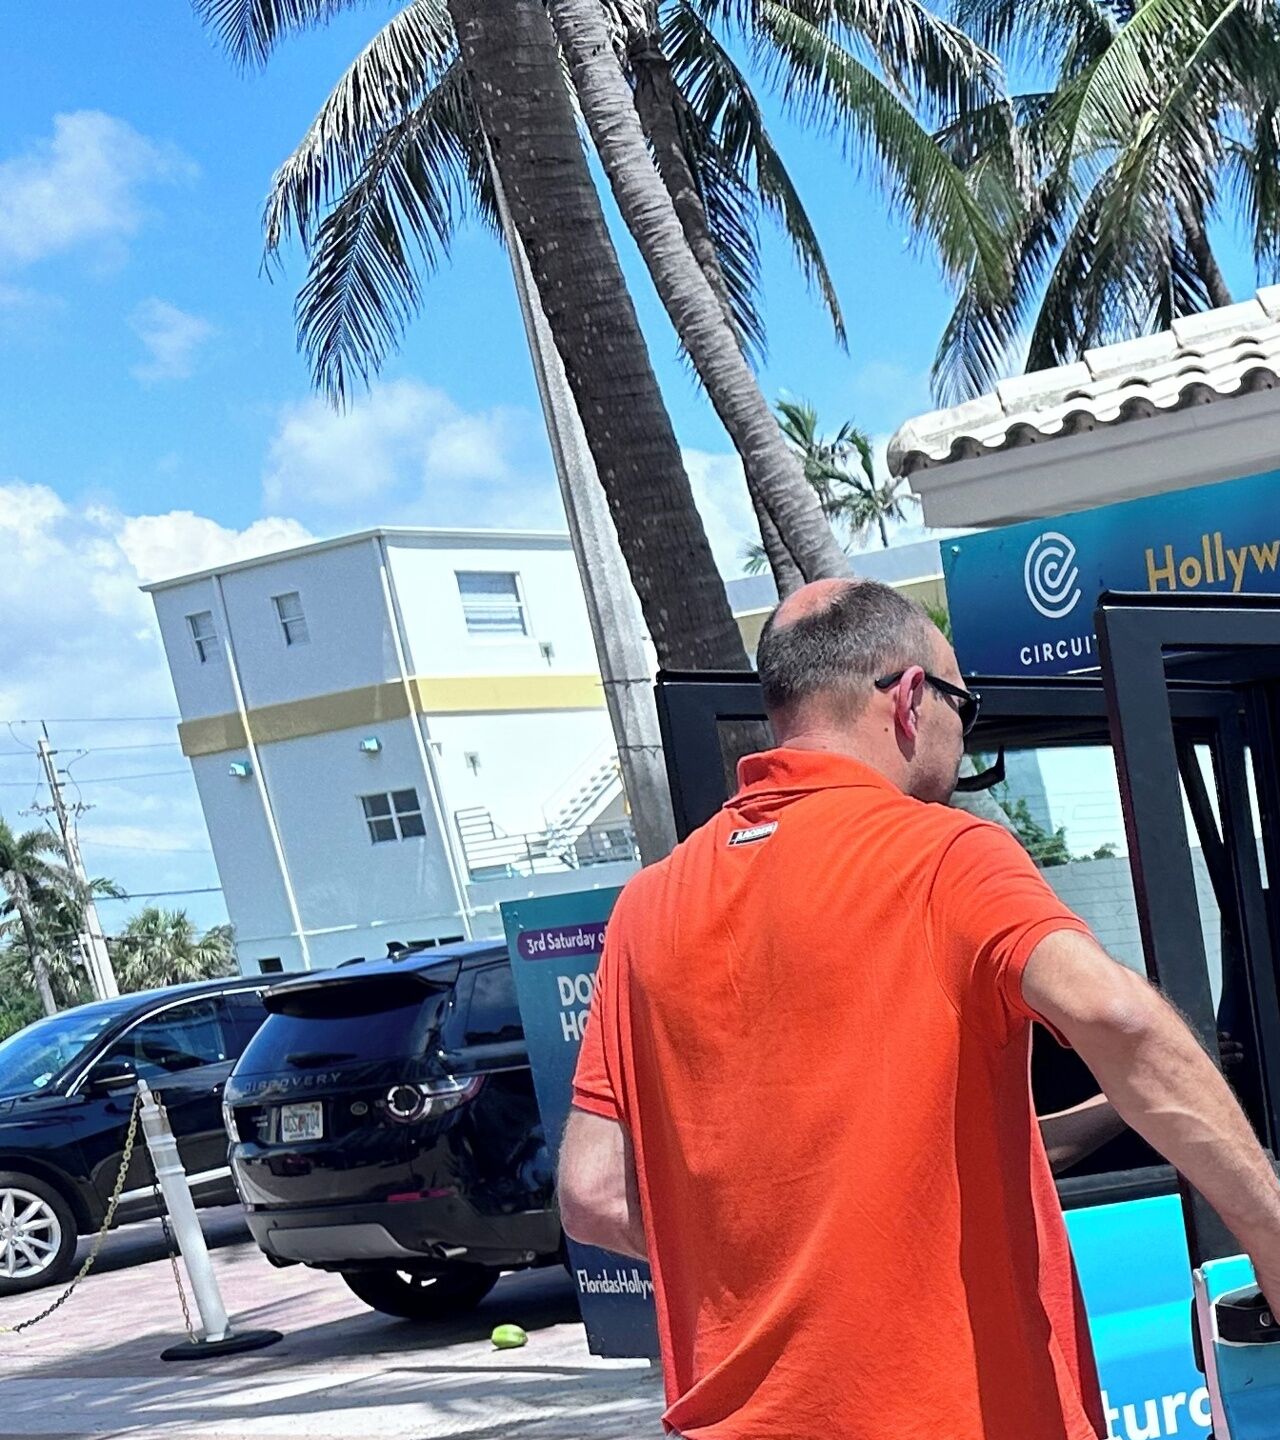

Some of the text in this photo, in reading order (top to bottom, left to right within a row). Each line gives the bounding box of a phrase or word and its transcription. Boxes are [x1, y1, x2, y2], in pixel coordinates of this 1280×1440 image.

[1020, 634, 1098, 666] CIRCUI
[526, 933, 545, 955] 3rd
[546, 929, 595, 950] Saturday
